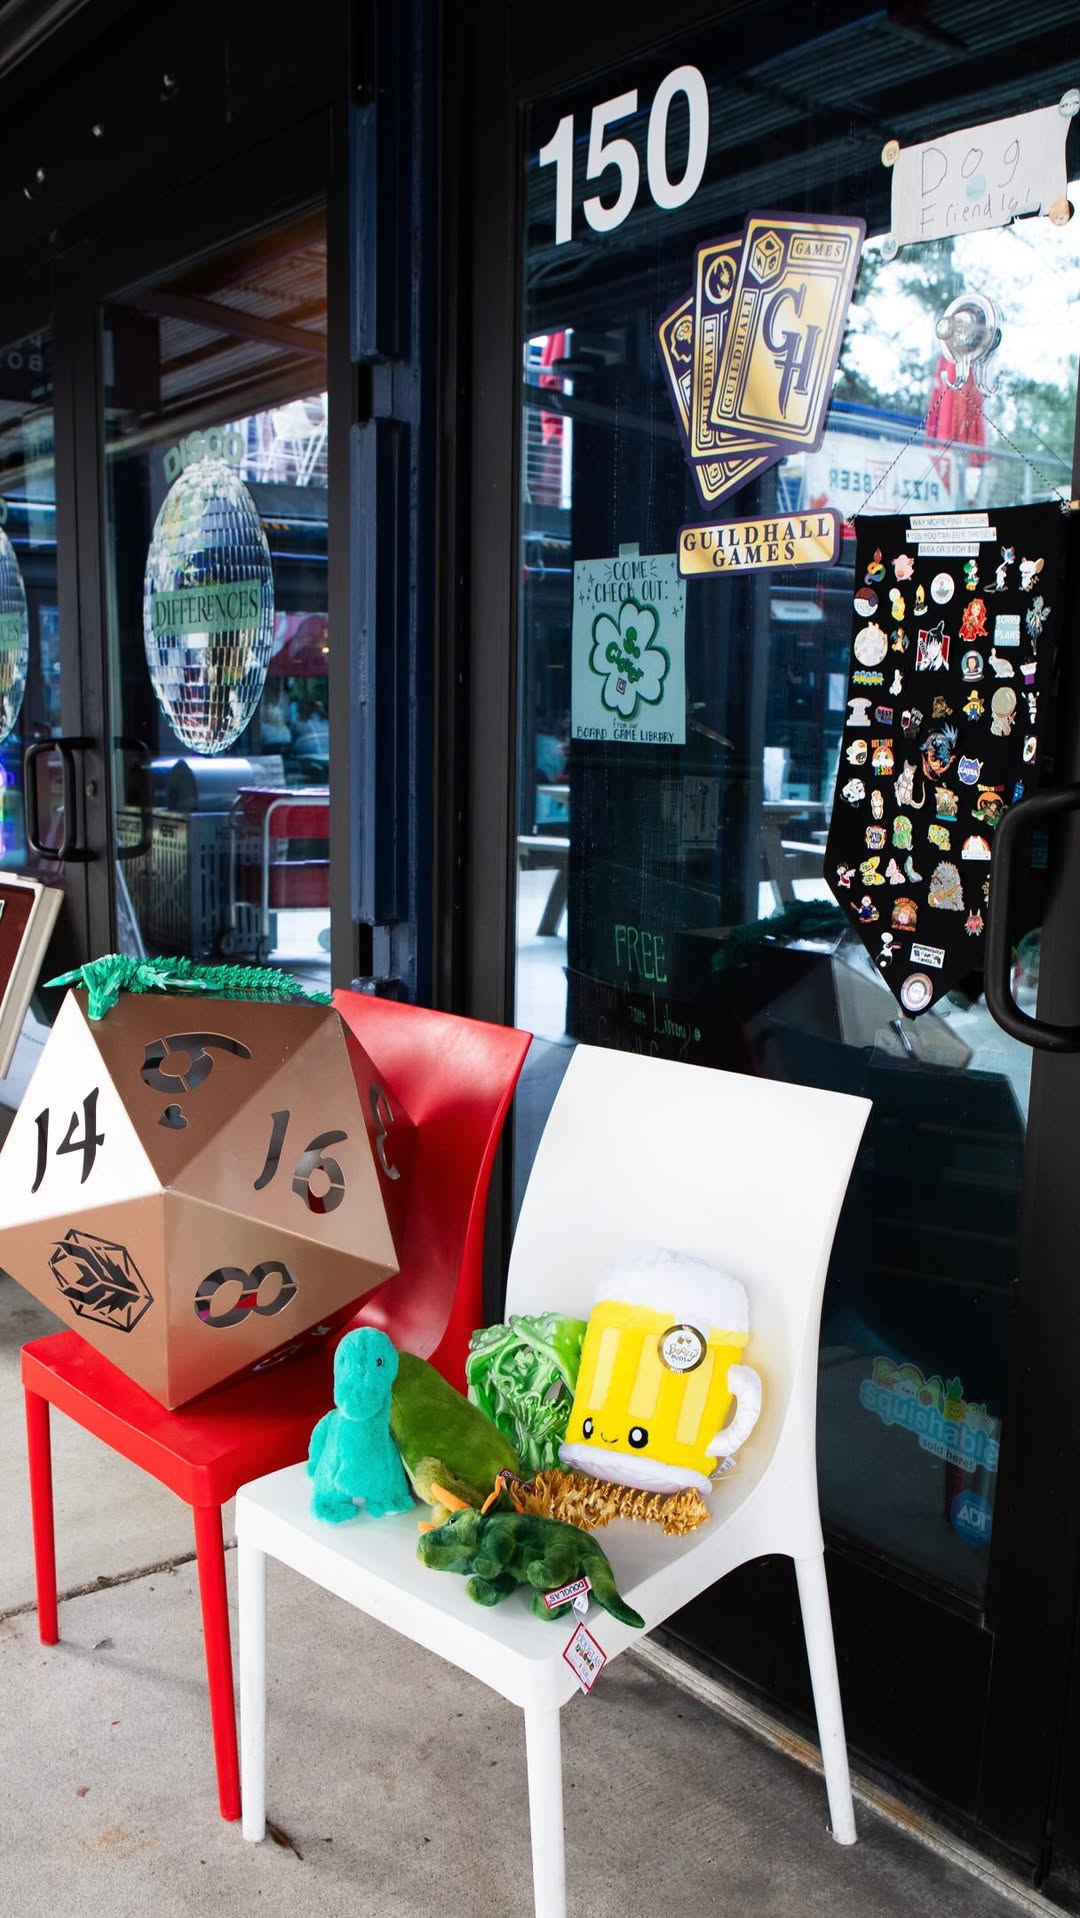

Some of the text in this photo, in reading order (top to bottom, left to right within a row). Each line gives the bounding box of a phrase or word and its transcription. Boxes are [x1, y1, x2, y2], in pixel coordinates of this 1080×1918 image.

[539, 65, 709, 245] 150
[921, 139, 1020, 199] Dog
[795, 239, 843, 257] GAMES
[701, 323, 714, 438] GUILDHALL
[723, 296, 753, 408] GUILDHALL
[163, 427, 244, 484] DISCO
[683, 518, 830, 551] GUILDHALL
[712, 541, 795, 567] GAMES
[595, 582, 634, 603] CHECK
[613, 561, 648, 581] COME
[155, 589, 258, 628] DIFFERENCES
[577, 726, 675, 743] BOARD GAME LIBRARY
[614, 924, 667, 983] FREE
[31, 1086, 105, 1193] 14
[254, 1109, 348, 1214] 16
[194, 1261, 299, 1328] 8
[863, 1386, 998, 1466] squishable
[957, 1503, 990, 1532] ADT
[549, 1580, 585, 1604] DOUGLAS
